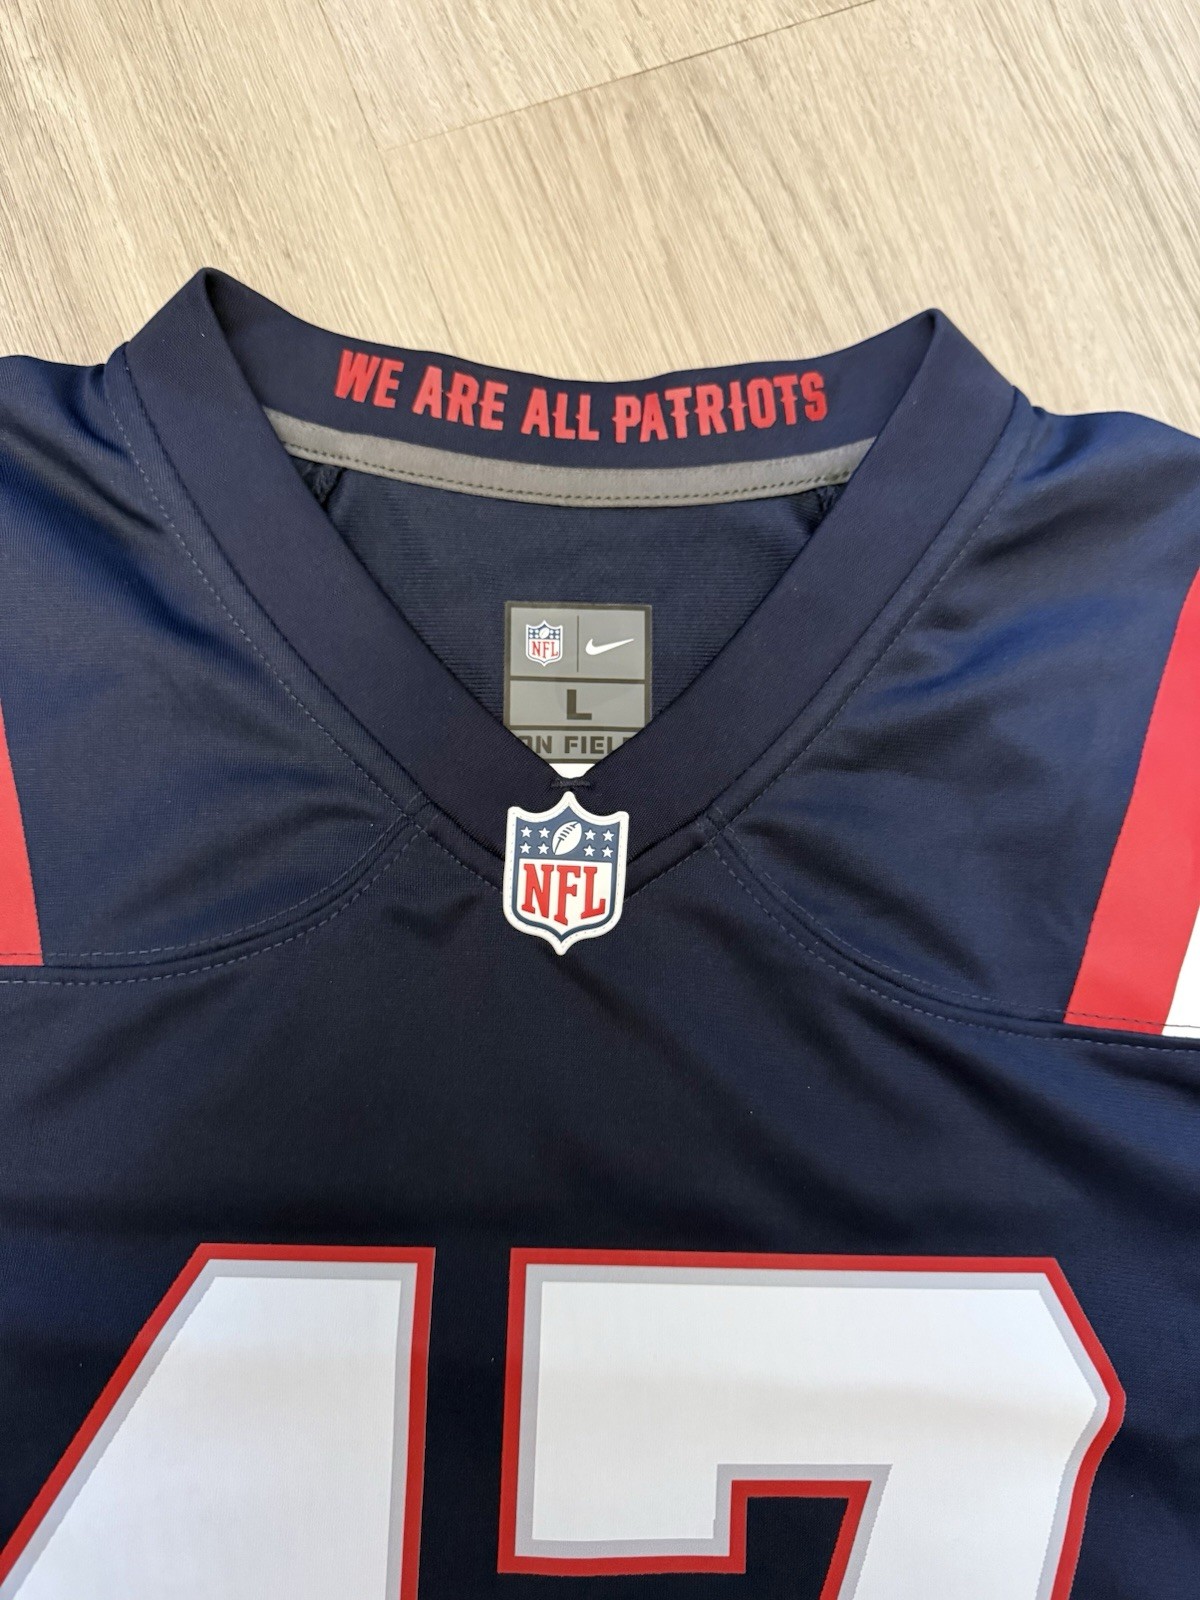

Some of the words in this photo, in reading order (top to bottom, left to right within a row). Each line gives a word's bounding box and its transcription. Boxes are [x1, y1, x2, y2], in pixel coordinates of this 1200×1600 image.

[334, 349, 404, 409] WE
[412, 365, 508, 431] ARE
[520, 388, 599, 441] ALL
[613, 371, 827, 443] PATRIOTS
[531, 641, 559, 659] NFL
[566, 689, 592, 720] L
[564, 736, 634, 755] FIEL
[521, 863, 606, 926] NFL
